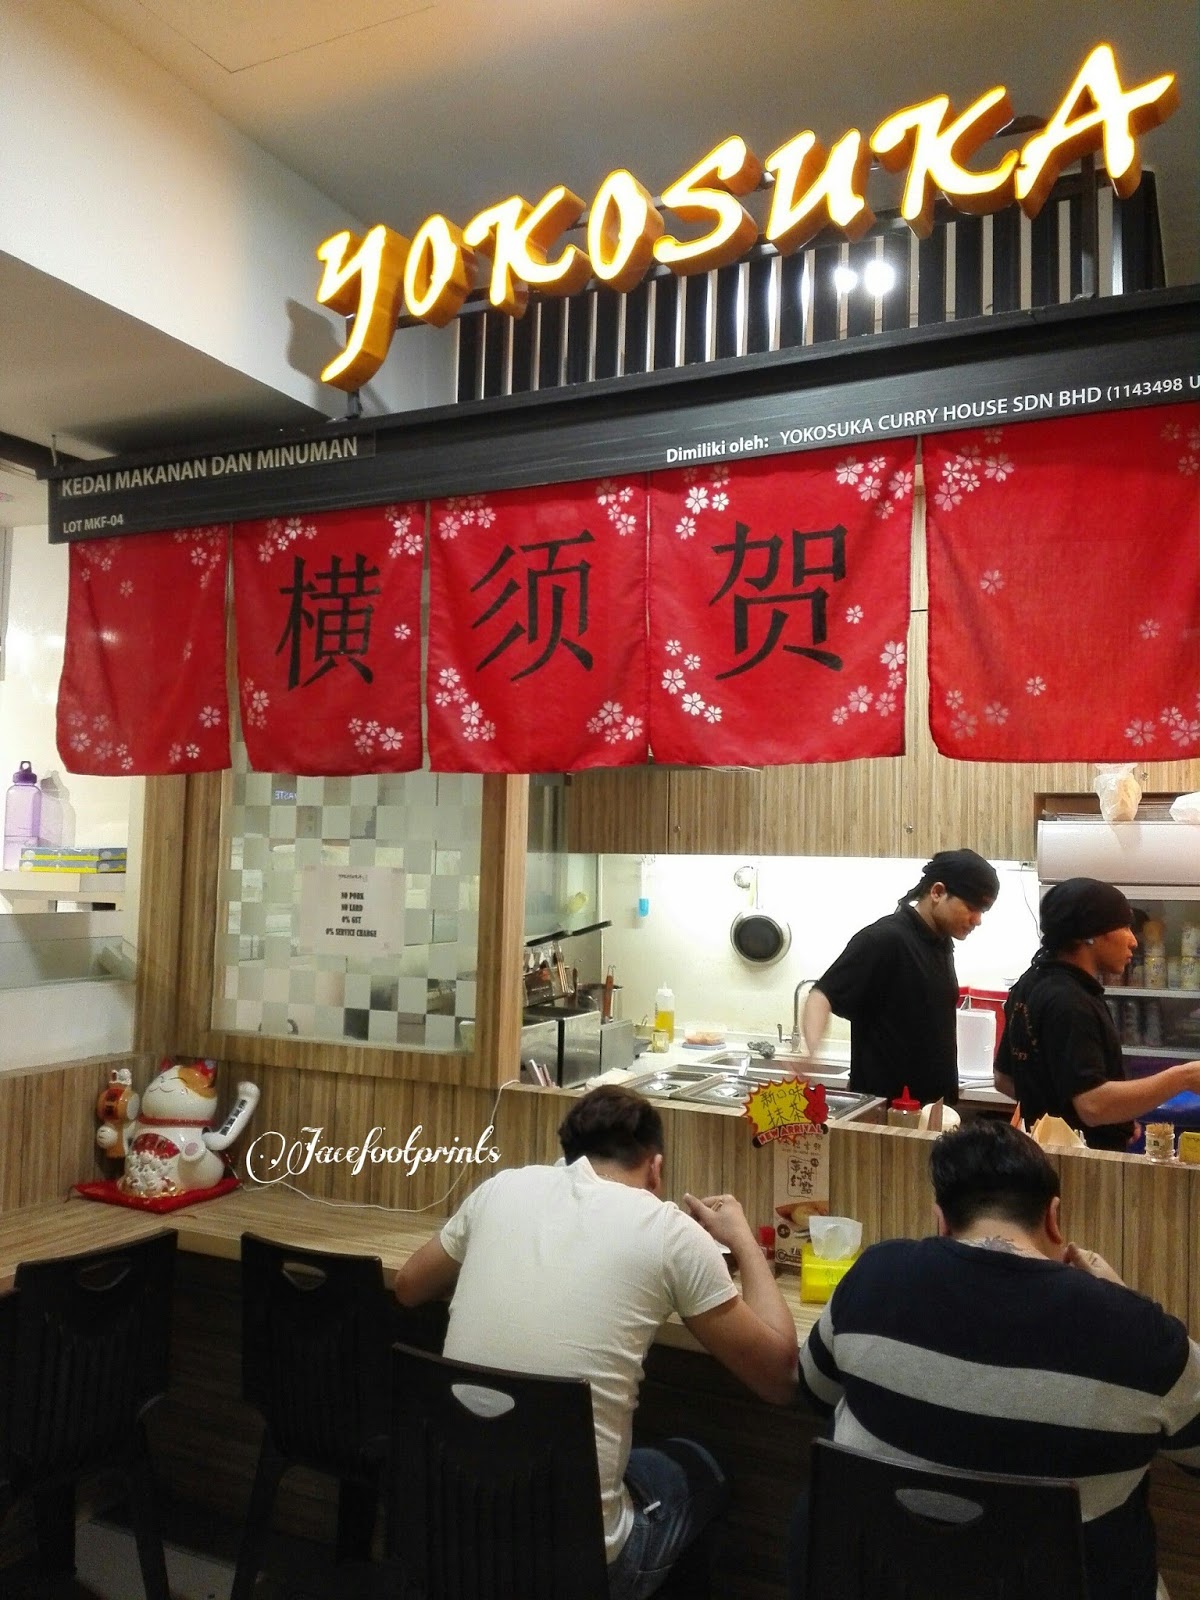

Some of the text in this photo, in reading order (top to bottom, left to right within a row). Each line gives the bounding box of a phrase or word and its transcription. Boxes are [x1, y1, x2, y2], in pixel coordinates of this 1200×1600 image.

[316, 42, 1180, 389] YOKOSUKA
[666, 442, 726, 463] Dimiliki
[729, 436, 769, 454] oleh:
[780, 418, 873, 446] YOKOSUKA
[878, 407, 938, 431] CURRY
[943, 398, 1008, 422] HOUSE
[1012, 392, 1053, 413] SDN
[1059, 386, 1102, 407] BHD
[1107, 377, 1183, 402] (1143498
[62, 436, 357, 497] KEDAI MAKANAN DAN MINUMAN
[63, 513, 124, 534] LOT MKF-04
[760, 1083, 805, 1109] 新口味
[758, 1127, 780, 1146] NEW
[780, 1123, 823, 1137] ARRIVAL
